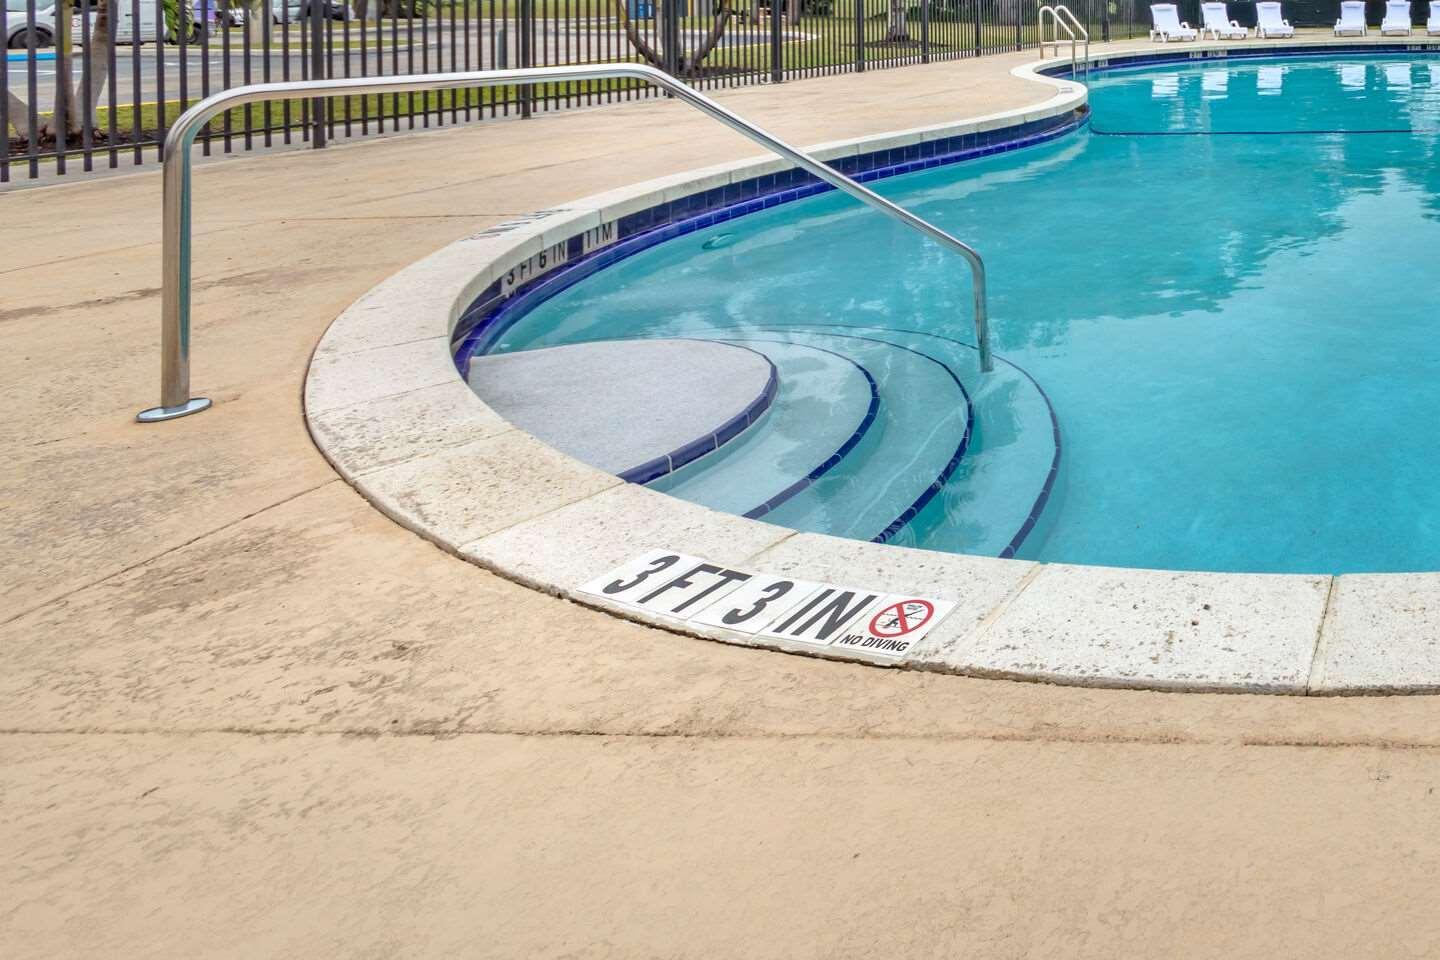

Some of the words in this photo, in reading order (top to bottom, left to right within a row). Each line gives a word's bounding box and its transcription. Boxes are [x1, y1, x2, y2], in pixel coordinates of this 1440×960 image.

[552, 240, 566, 263] IN
[602, 555, 681, 595] 3
[636, 563, 753, 613] FT
[721, 581, 795, 624] 3
[772, 588, 878, 640] IN
[840, 634, 863, 645] NO
[861, 637, 910, 652] DIVING
